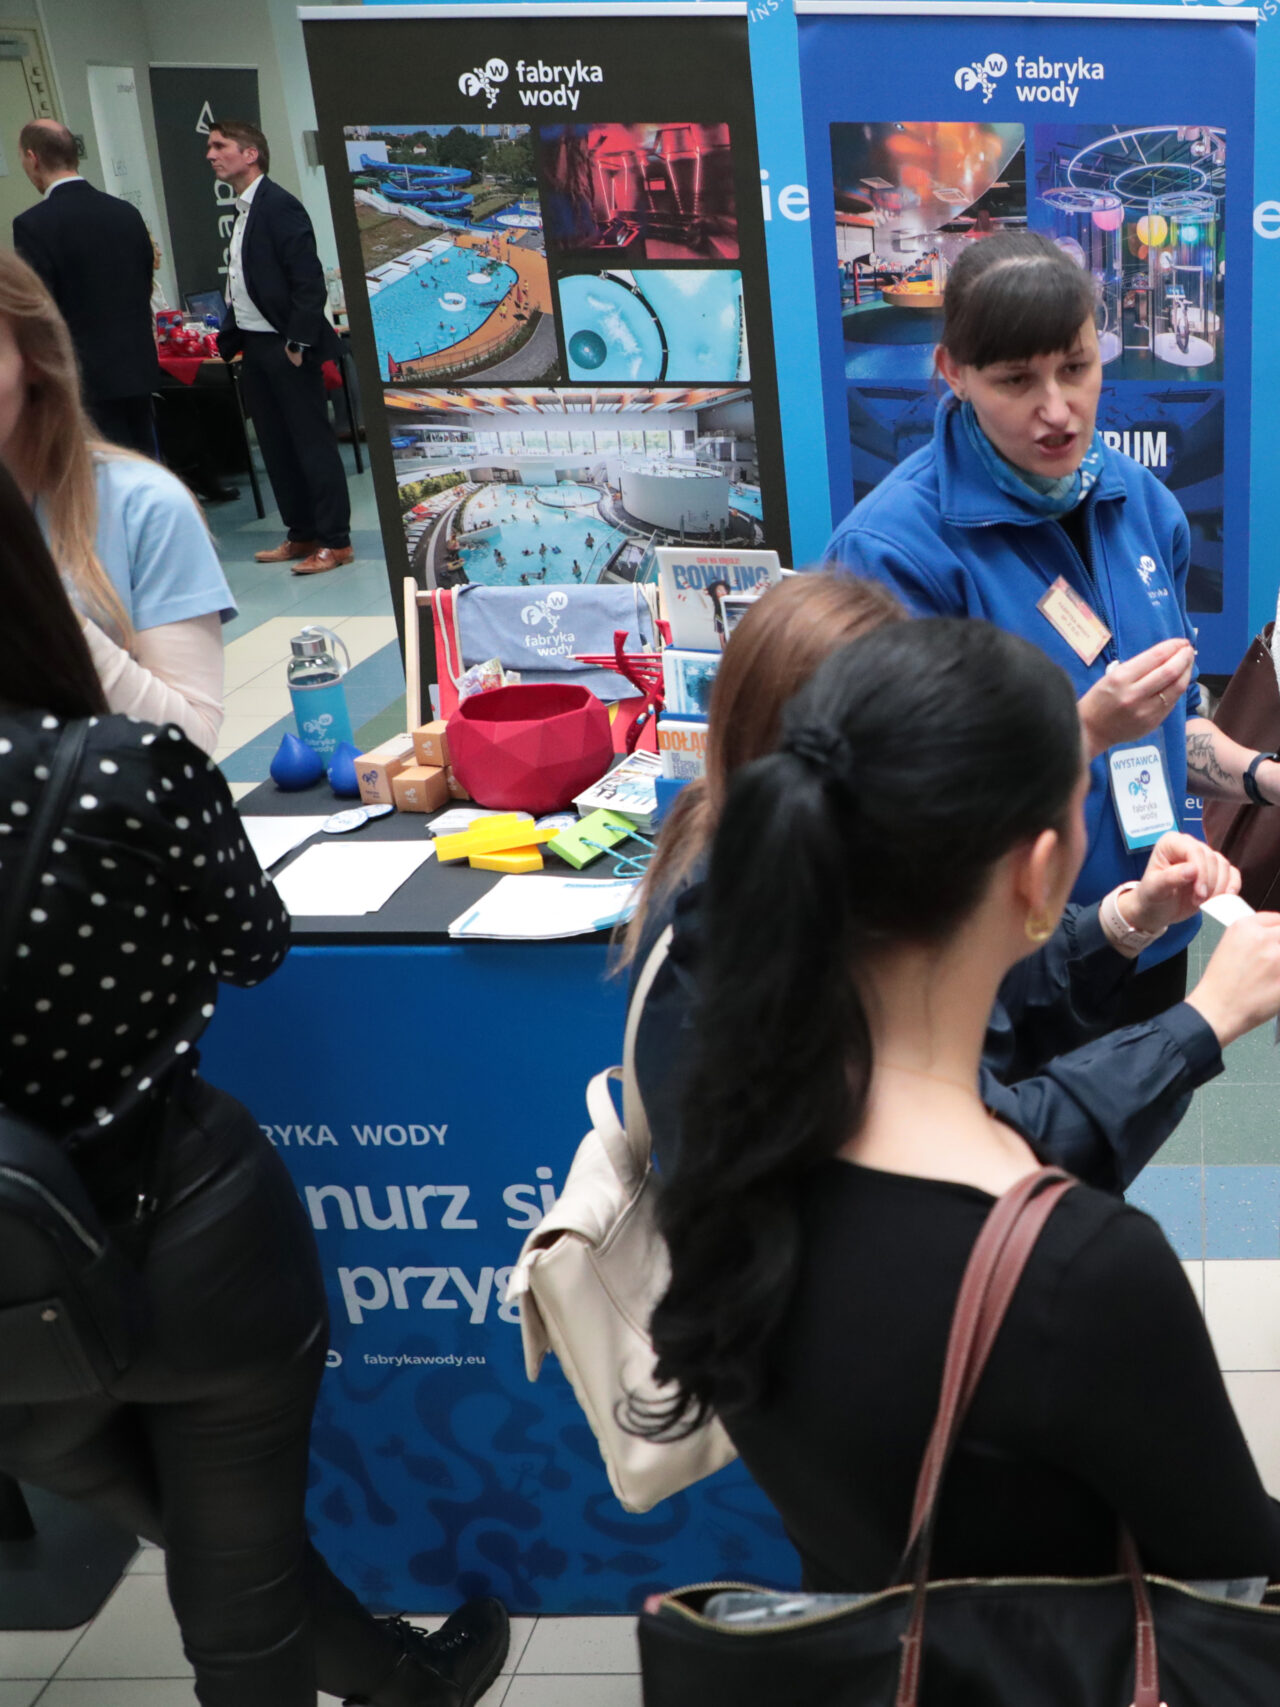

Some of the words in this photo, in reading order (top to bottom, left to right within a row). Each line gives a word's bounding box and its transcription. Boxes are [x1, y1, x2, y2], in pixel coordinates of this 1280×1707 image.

[516, 59, 604, 87] fabryka
[1015, 55, 1105, 84] fabryka
[519, 84, 580, 110] wody
[1016, 80, 1079, 107] wody
[1098, 431, 1167, 467] RUM
[525, 632, 575, 647] fabryka
[537, 643, 573, 656] wody
[657, 731, 709, 760] DOŁĄC
[1112, 754, 1160, 770] WYSTAWCA
[258, 1124, 340, 1147] RYKA
[351, 1124, 448, 1147] WODY
[303, 1184, 478, 1231] nurz
[502, 1166, 556, 1230] si
[363, 1353, 487, 1367] fabrykawody.eu
